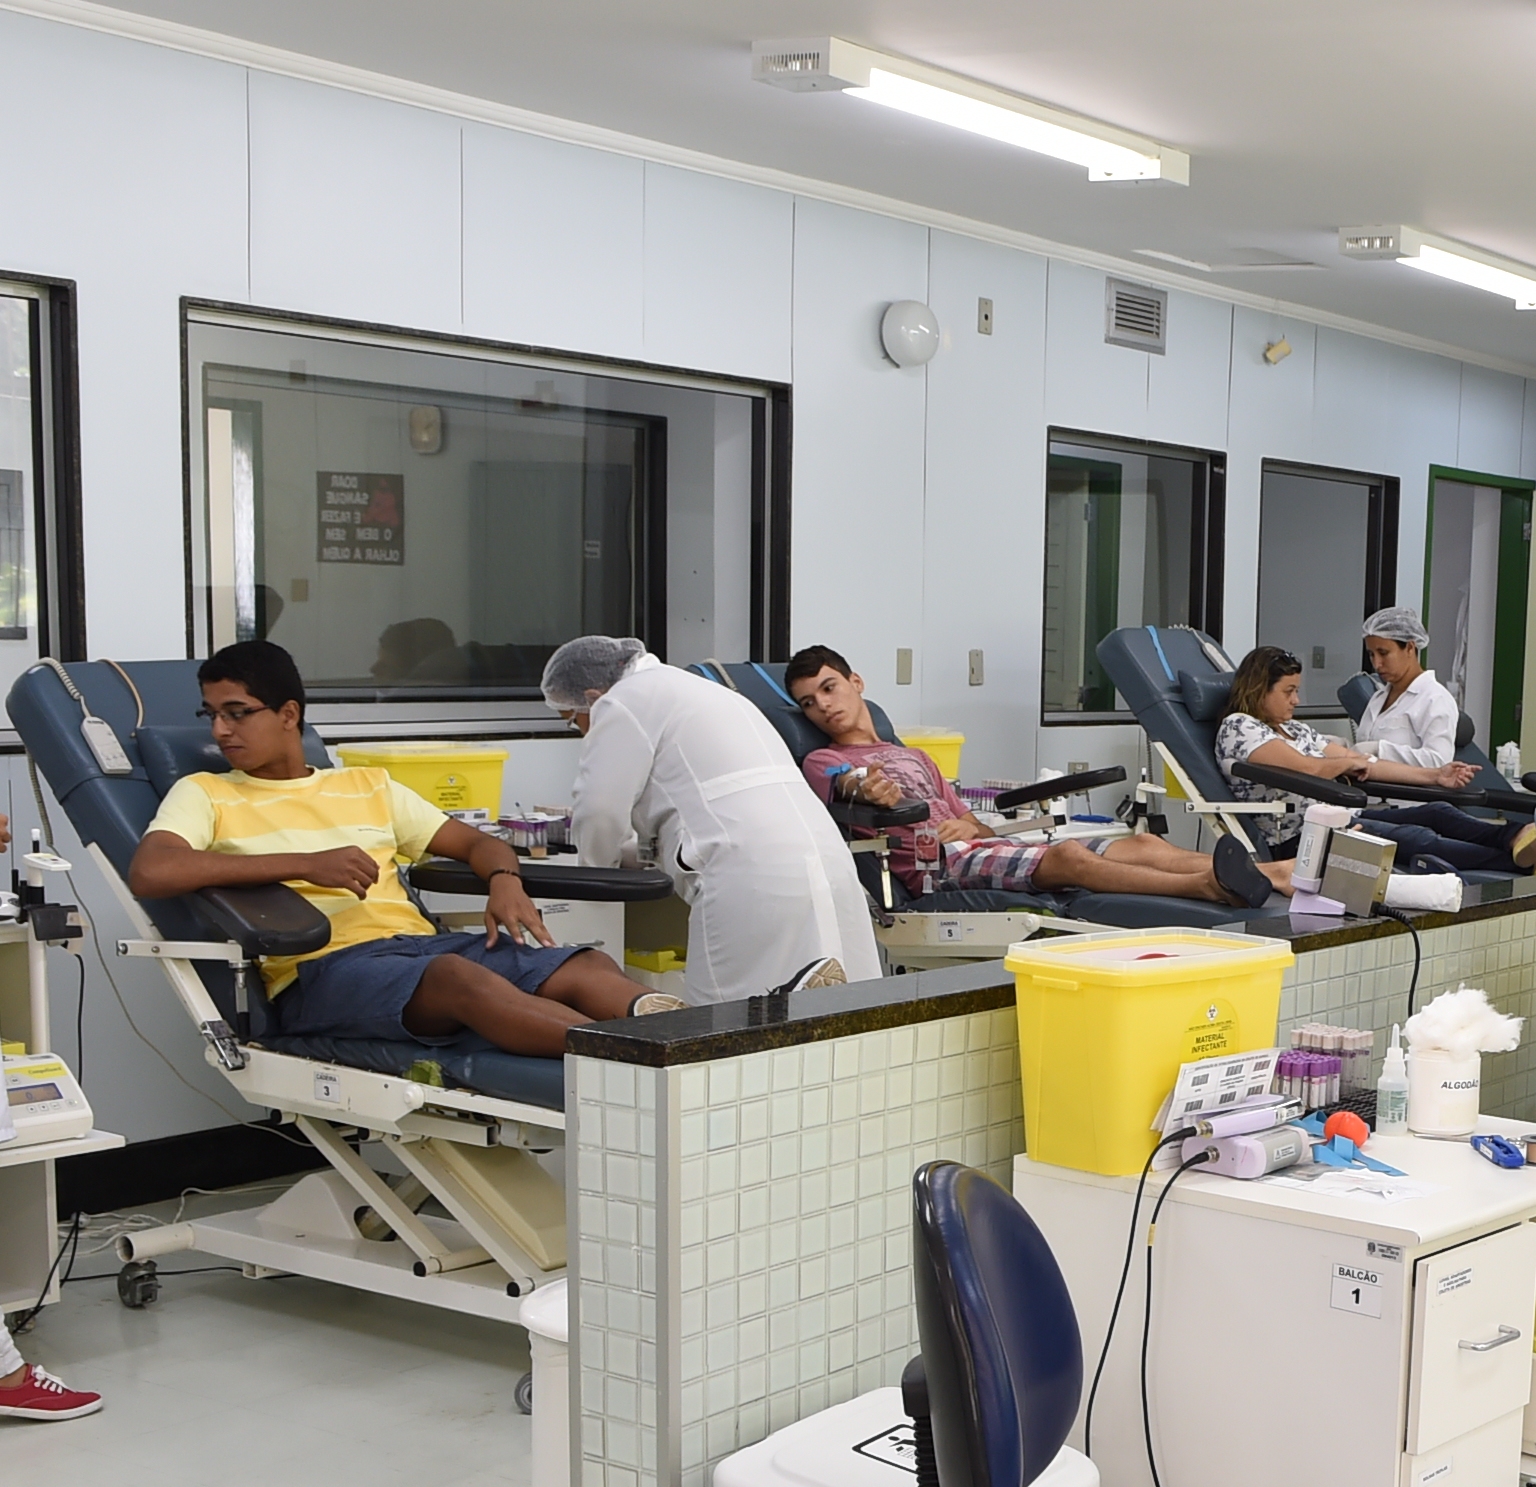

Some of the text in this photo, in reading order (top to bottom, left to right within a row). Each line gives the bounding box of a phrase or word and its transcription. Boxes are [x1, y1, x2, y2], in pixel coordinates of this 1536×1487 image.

[947, 929, 953, 937] 5
[1195, 1032, 1225, 1044] MATERIAL
[1191, 1040, 1227, 1054] INFECTANTE
[323, 1086, 330, 1097] 3
[1338, 1267, 1378, 1283] BALCÃO
[1351, 1288, 1360, 1304] 1
